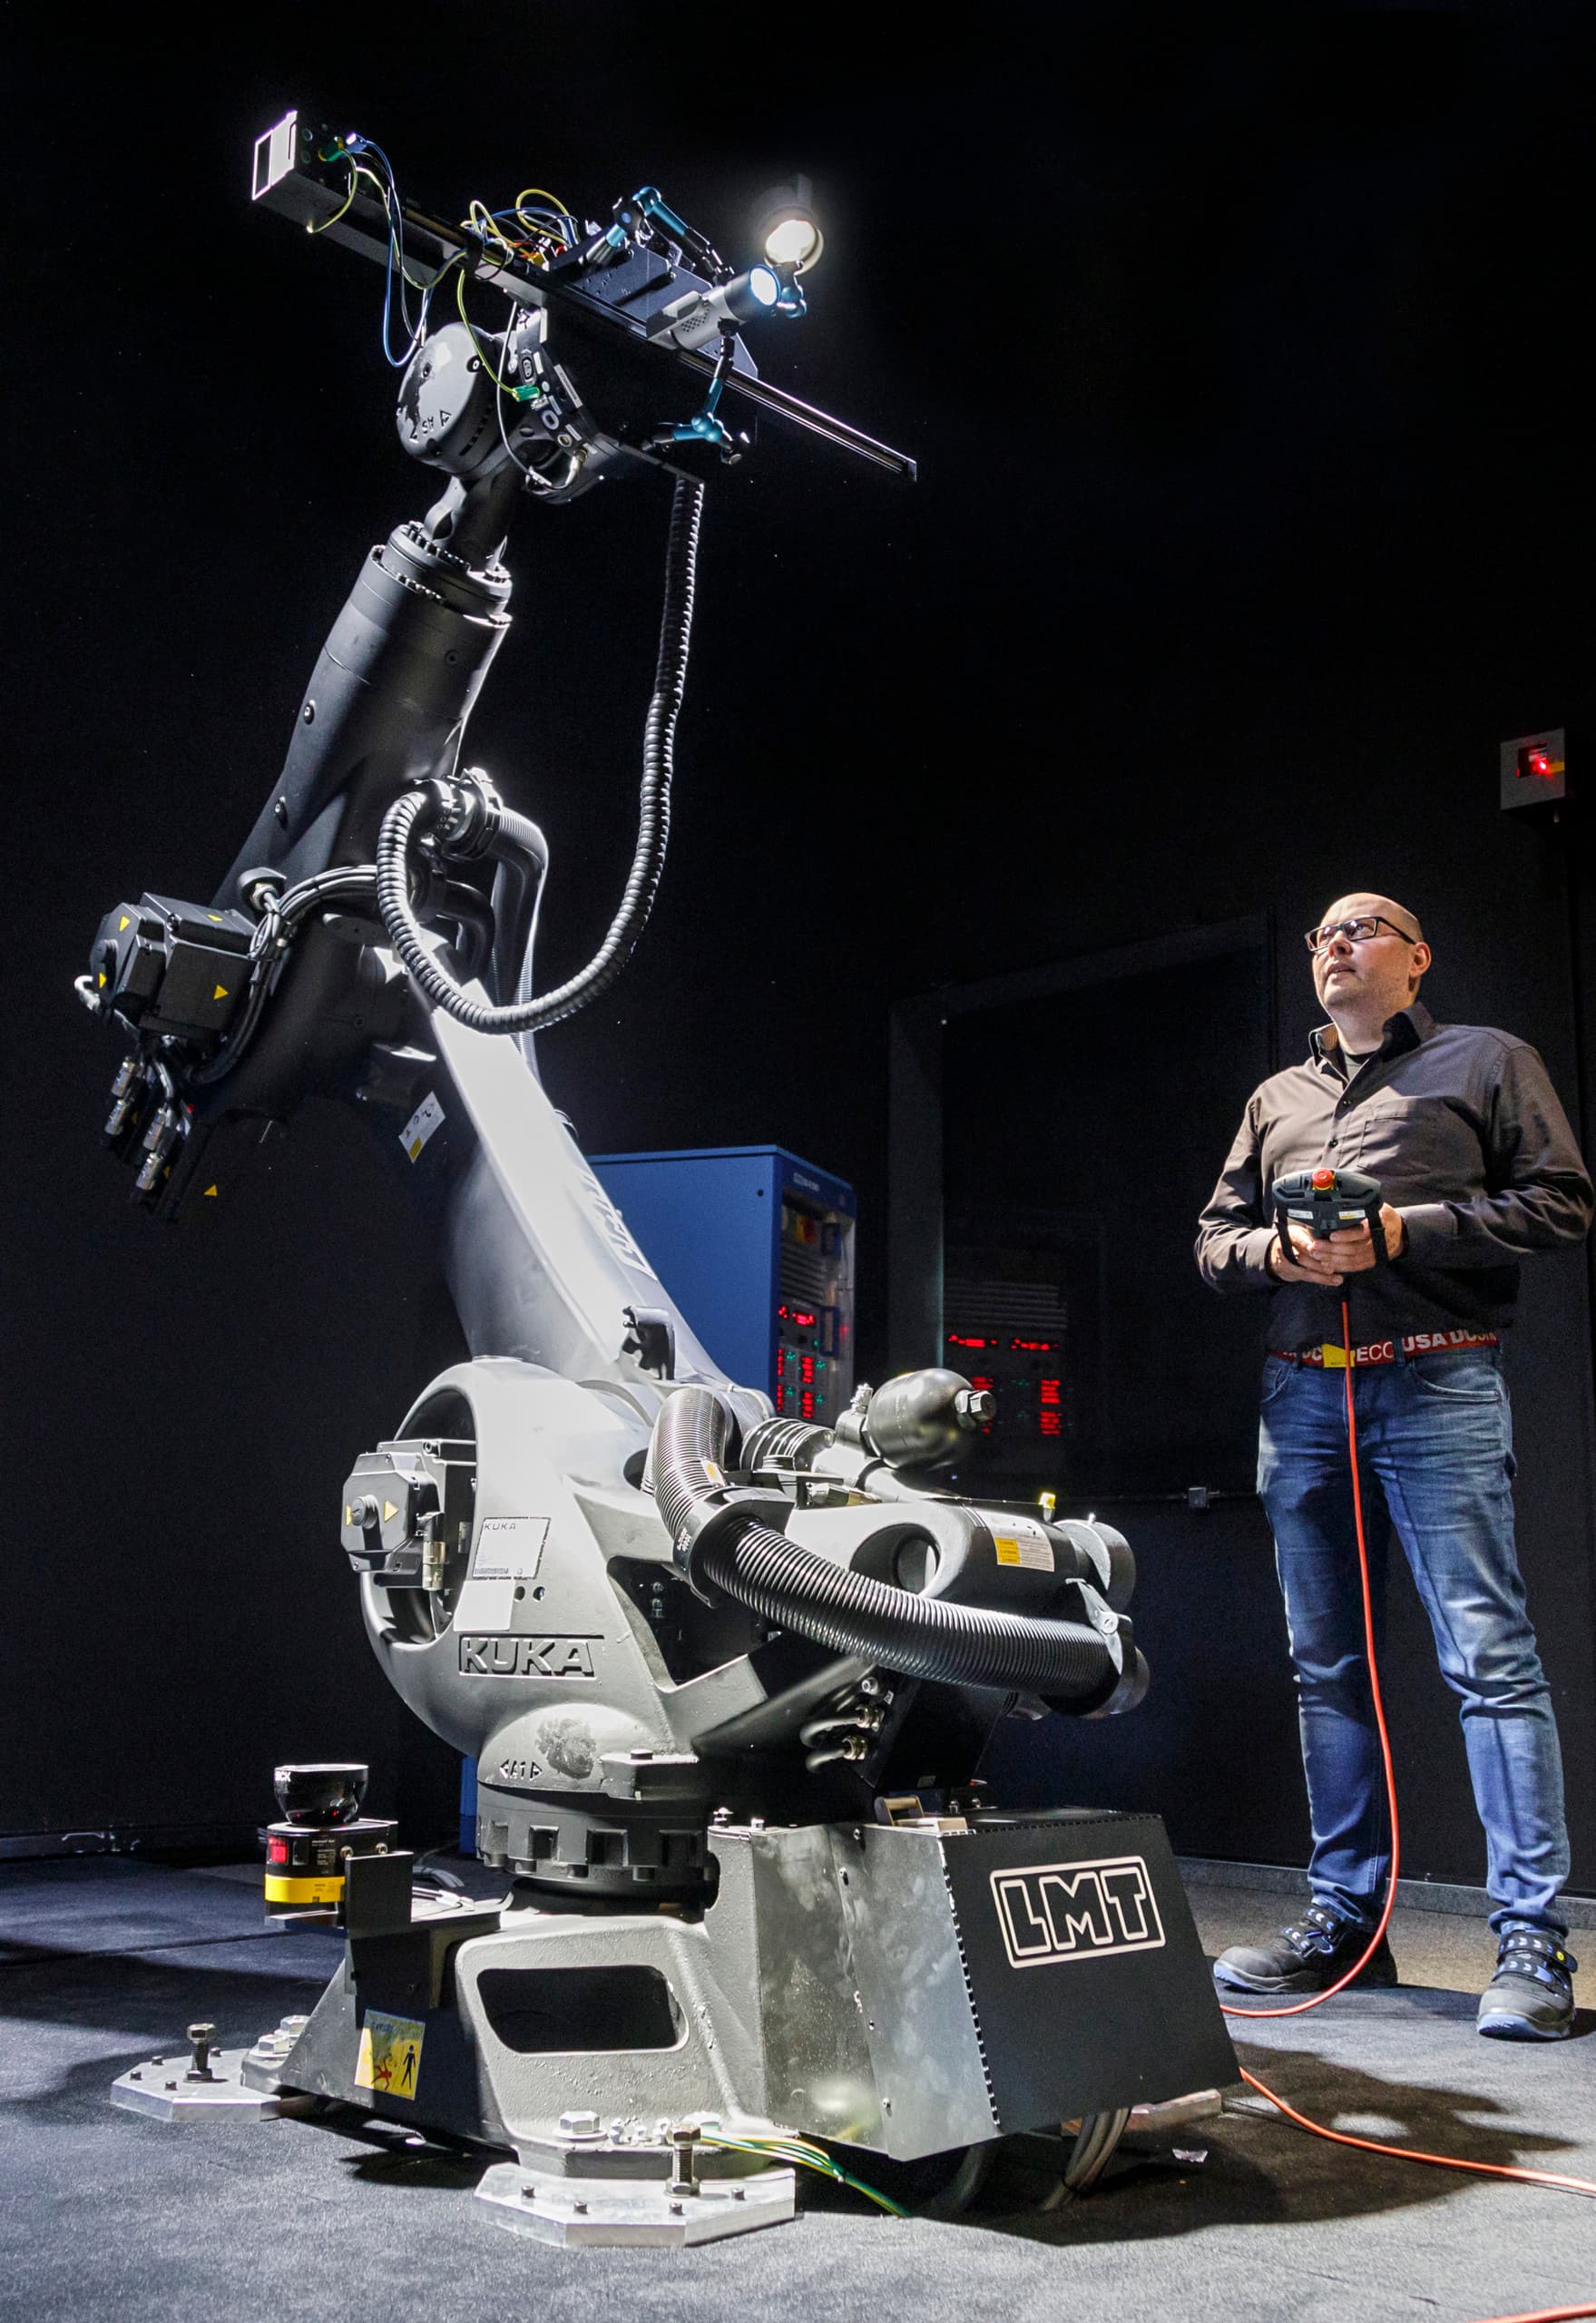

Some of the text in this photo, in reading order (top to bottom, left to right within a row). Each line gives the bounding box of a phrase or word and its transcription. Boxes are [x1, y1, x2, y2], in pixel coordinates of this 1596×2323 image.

[1402, 1333, 1448, 1351] USA
[484, 1523, 516, 1531] KUKA
[462, 1638, 596, 1677] KUKA
[1000, 1867, 1149, 1956] LMT
